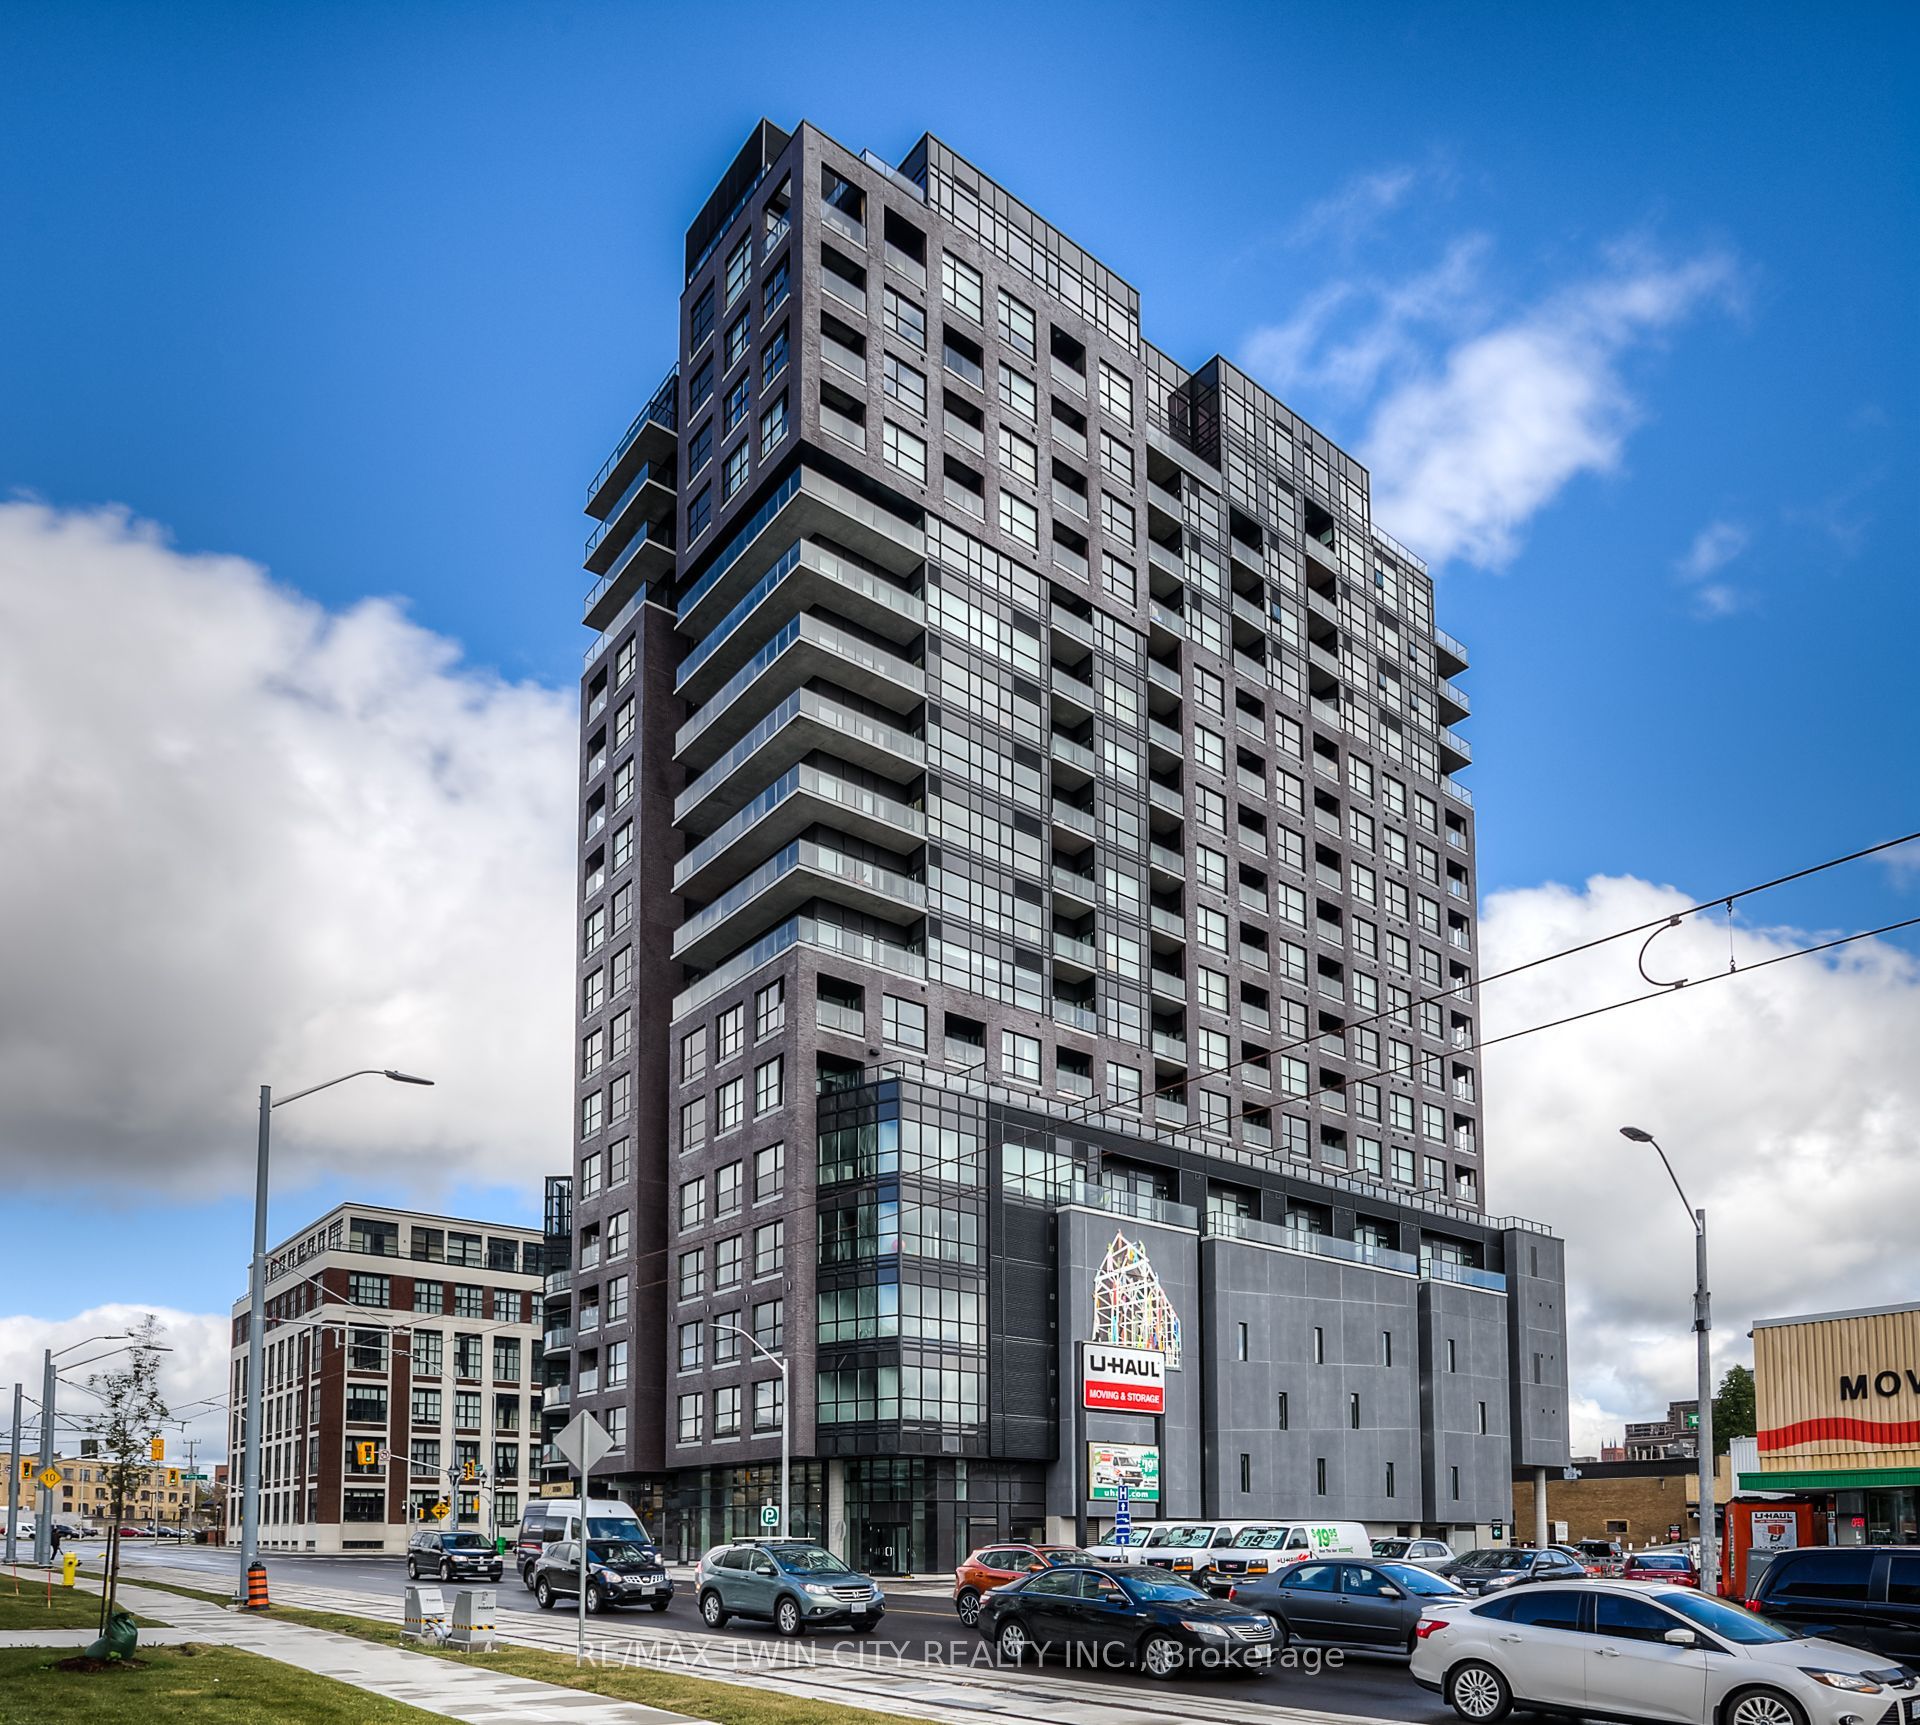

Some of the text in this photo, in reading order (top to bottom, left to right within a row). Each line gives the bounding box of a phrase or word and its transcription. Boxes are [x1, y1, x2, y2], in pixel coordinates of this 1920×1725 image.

[1090, 1355, 1159, 1377] U-HAUL
[1840, 1369, 1920, 1401] MOV
[1089, 1389, 1160, 1404] MOVING & STORAGE
[45, 1473, 55, 1481] 10
[1103, 1489, 1149, 1498] uh.com
[1119, 1487, 1127, 1500] H
